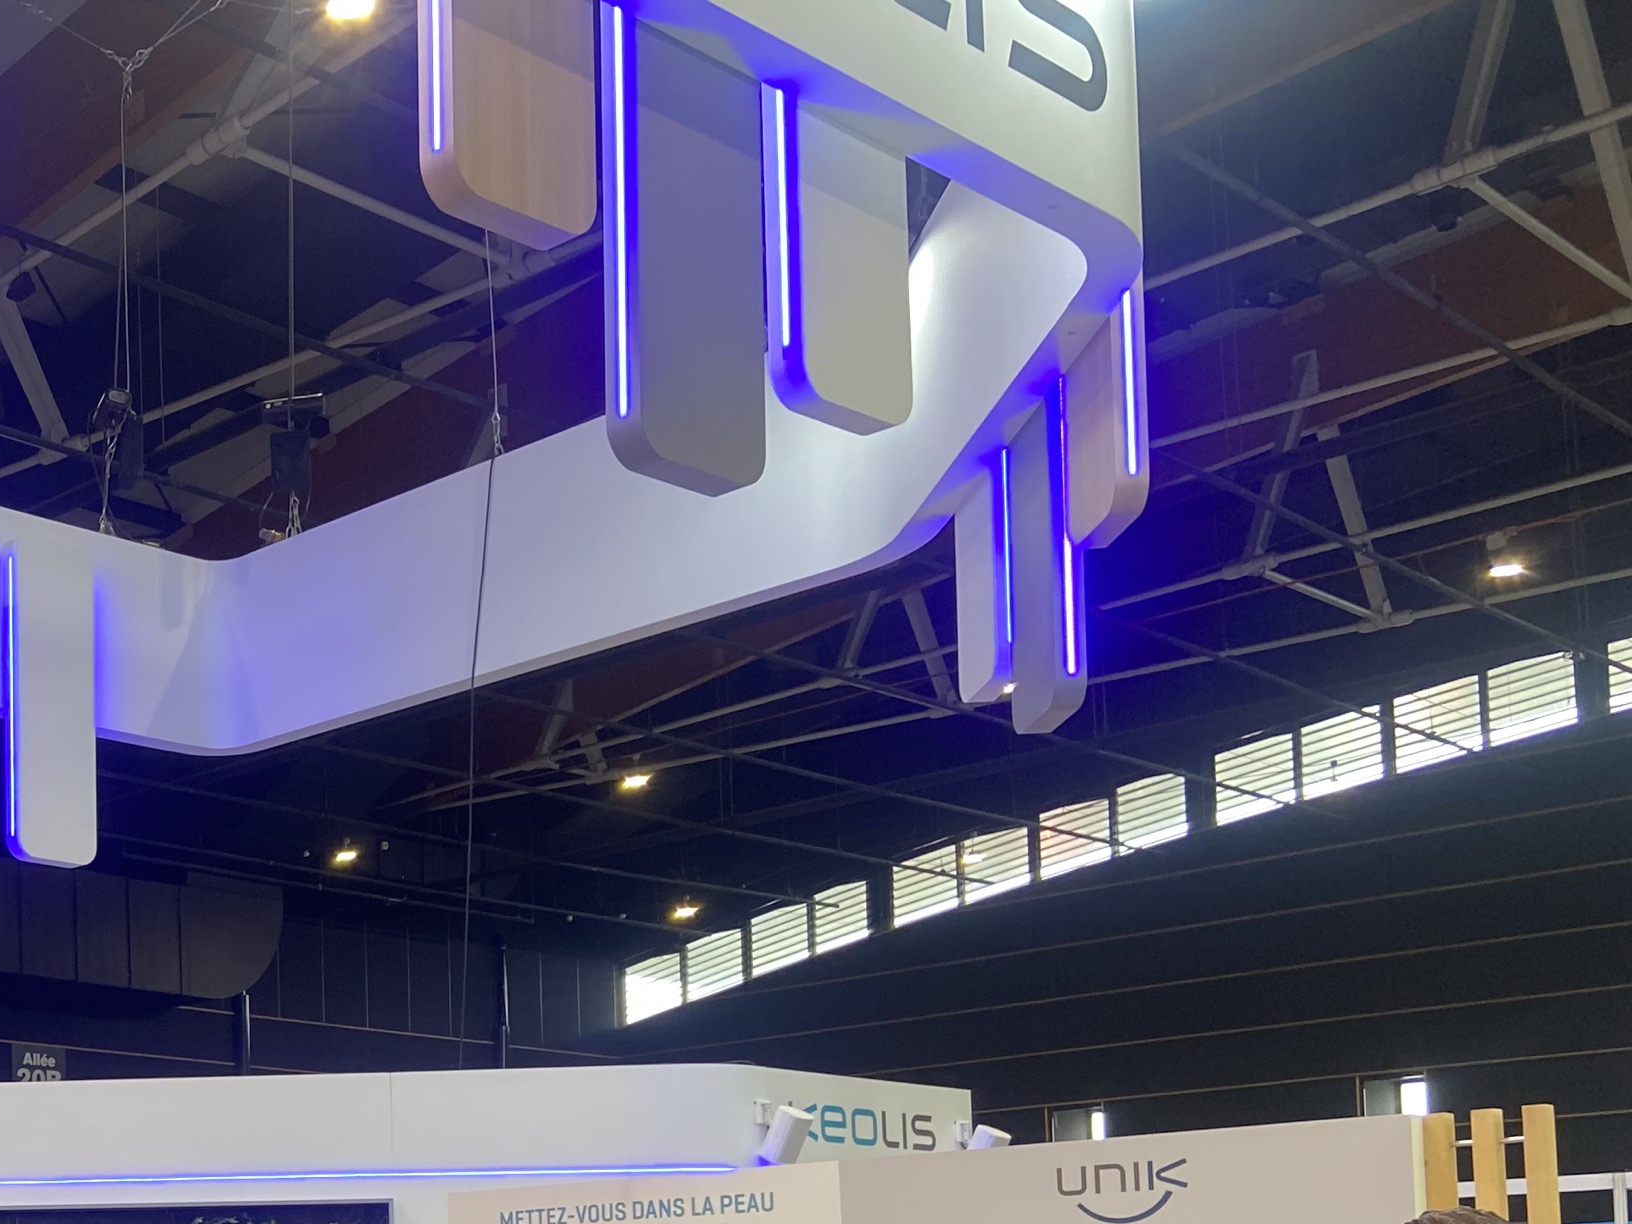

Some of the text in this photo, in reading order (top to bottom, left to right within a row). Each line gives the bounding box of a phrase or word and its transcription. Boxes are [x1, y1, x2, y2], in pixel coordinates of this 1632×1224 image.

[22, 1051, 56, 1067] Allée
[631, 1197, 685, 1220] DANS
[690, 1195, 715, 1216] LA
[719, 1191, 775, 1214] PEAU
